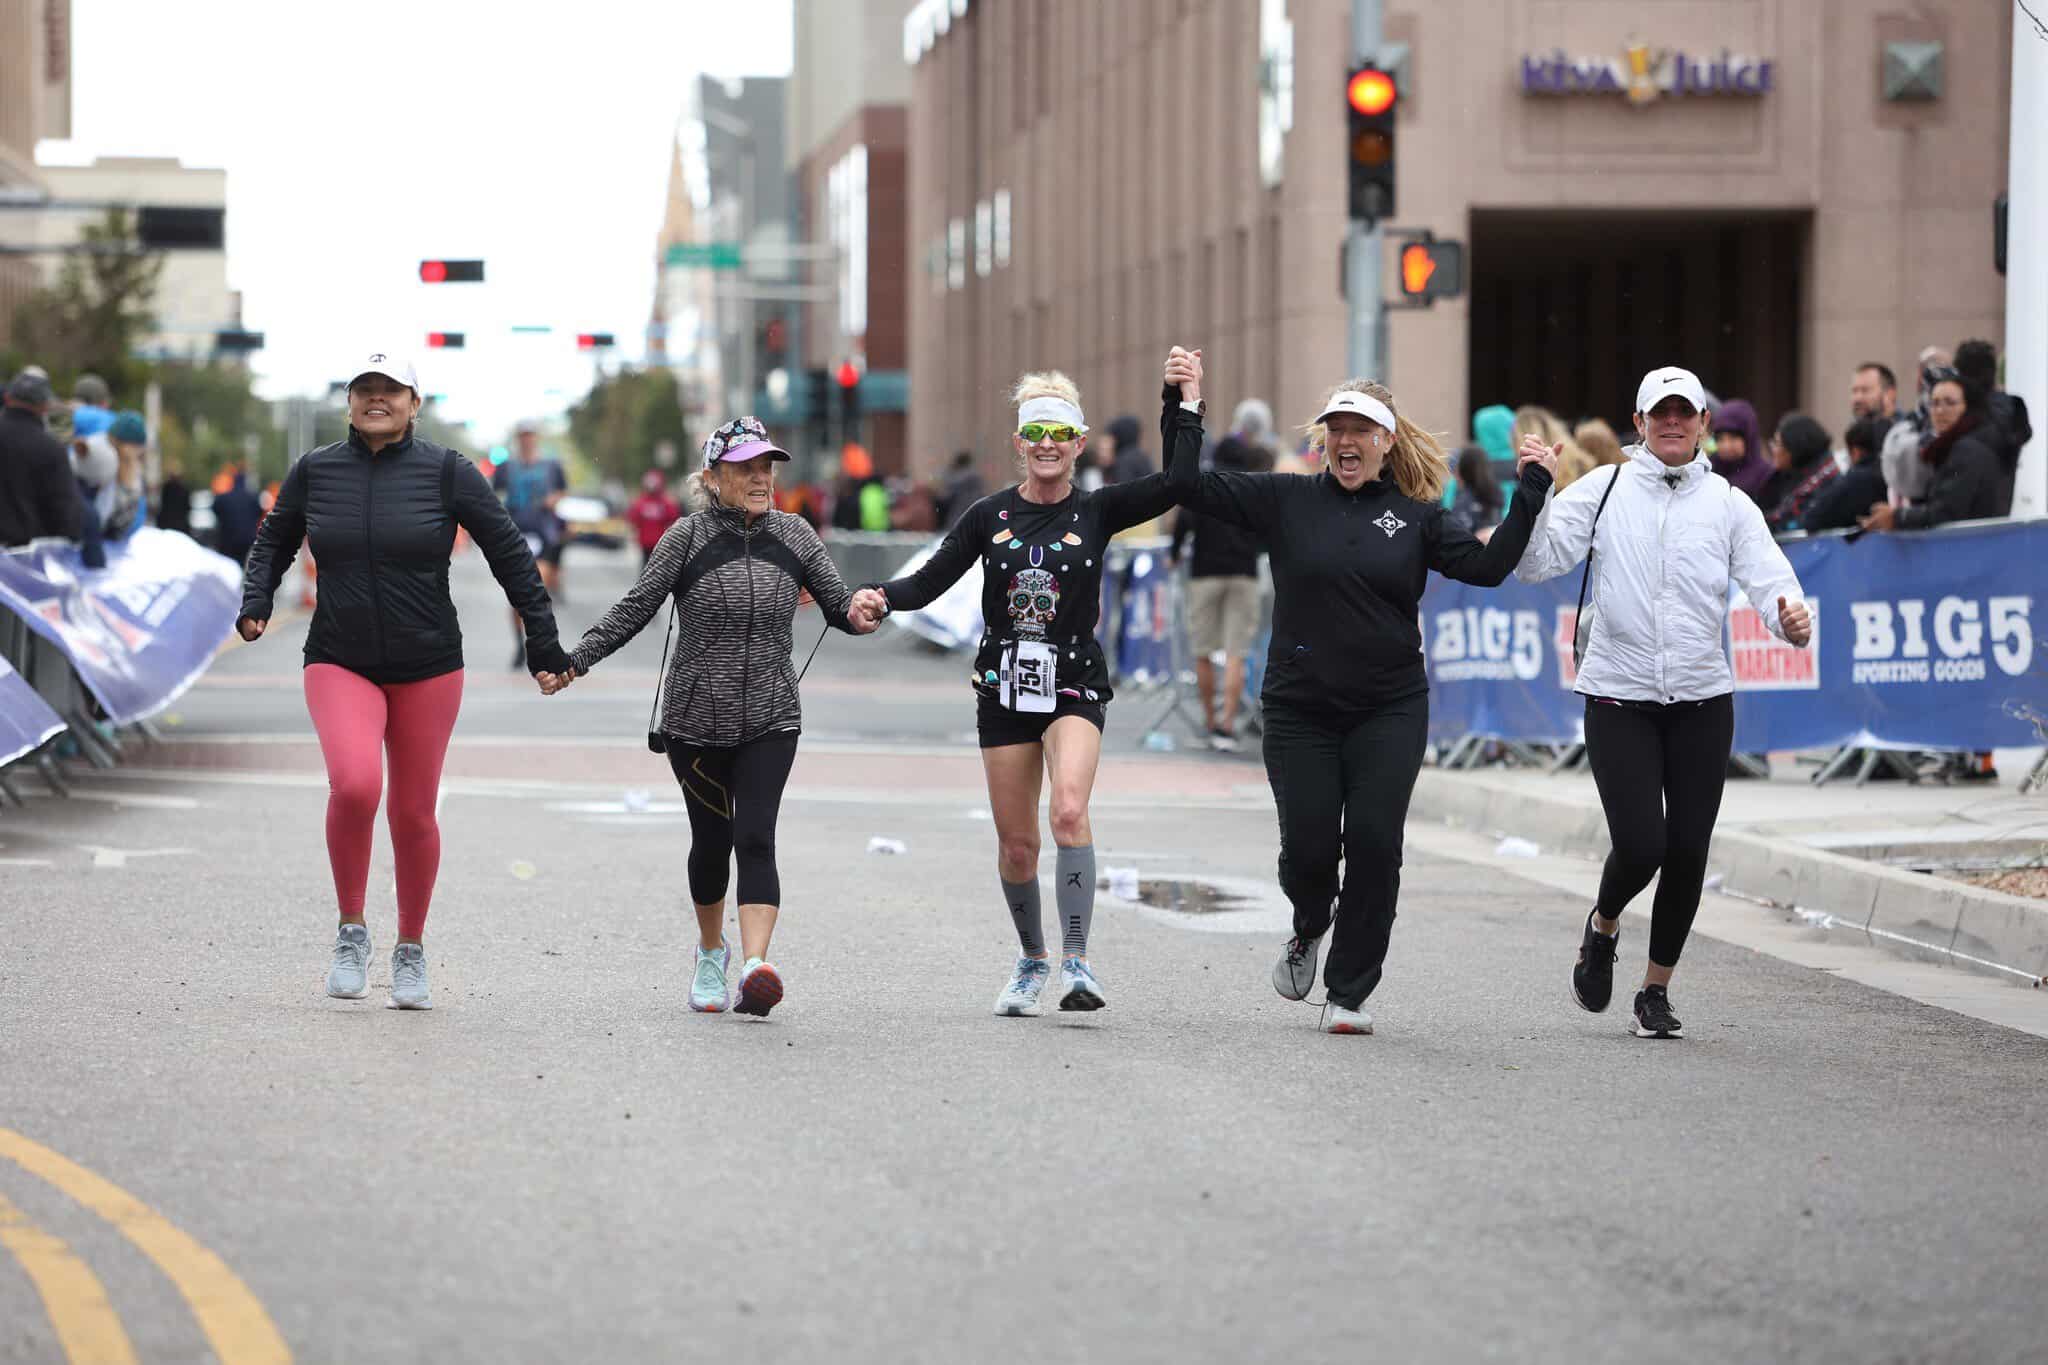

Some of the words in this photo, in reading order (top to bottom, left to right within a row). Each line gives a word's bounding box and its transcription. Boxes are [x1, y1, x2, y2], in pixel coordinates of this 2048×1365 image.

[1432, 606, 1510, 661] BIG
[1512, 609, 1543, 680] 5
[1850, 596, 1982, 659] BIG
[1989, 595, 2033, 676] 5
[1018, 658, 1041, 697] 754
[1852, 660, 1930, 683] SPORTING
[1933, 658, 1986, 682] GOODS
